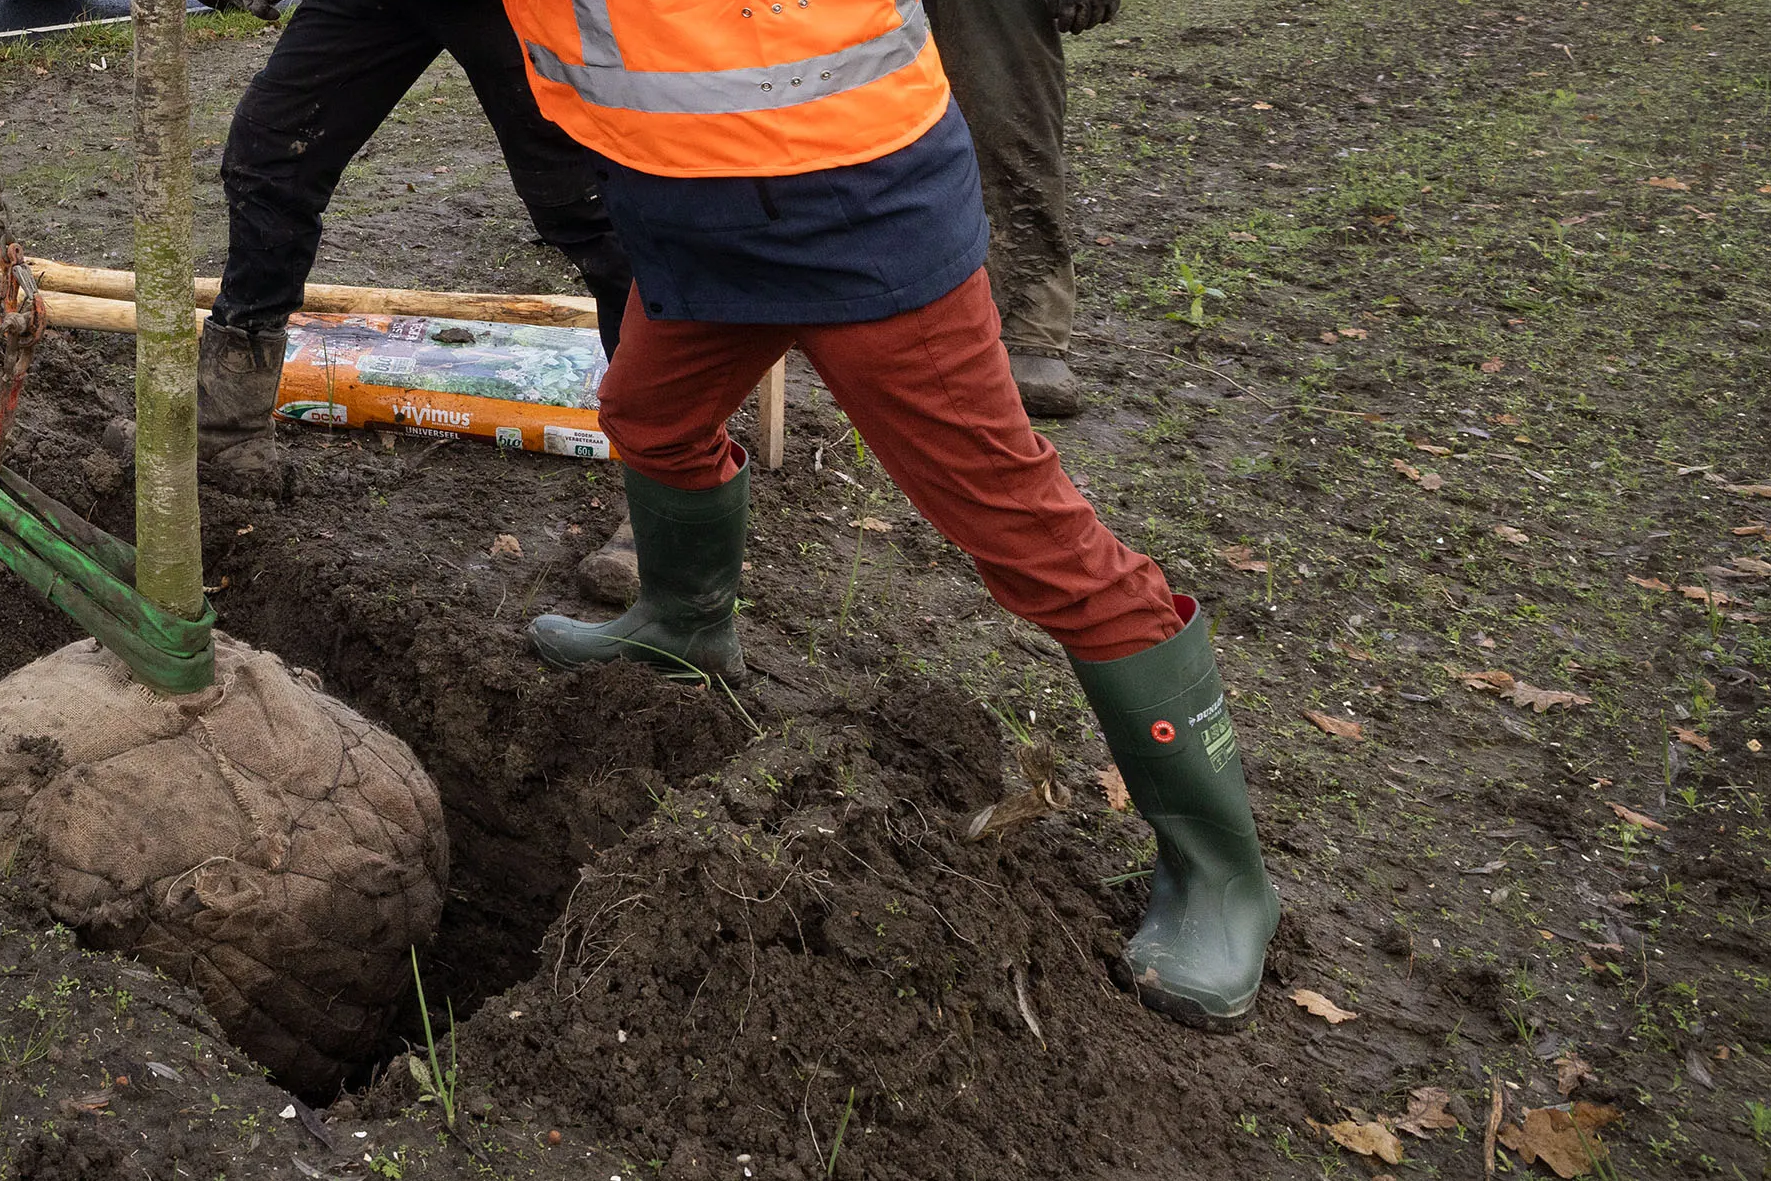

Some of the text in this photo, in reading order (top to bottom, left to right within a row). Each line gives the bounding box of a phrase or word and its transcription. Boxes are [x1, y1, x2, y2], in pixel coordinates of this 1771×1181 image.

[311, 412, 342, 422] DCM
[405, 426, 460, 440] UNIVERSEEL
[498, 434, 522, 448] bio
[565, 435, 604, 445] VERBETERAAR
